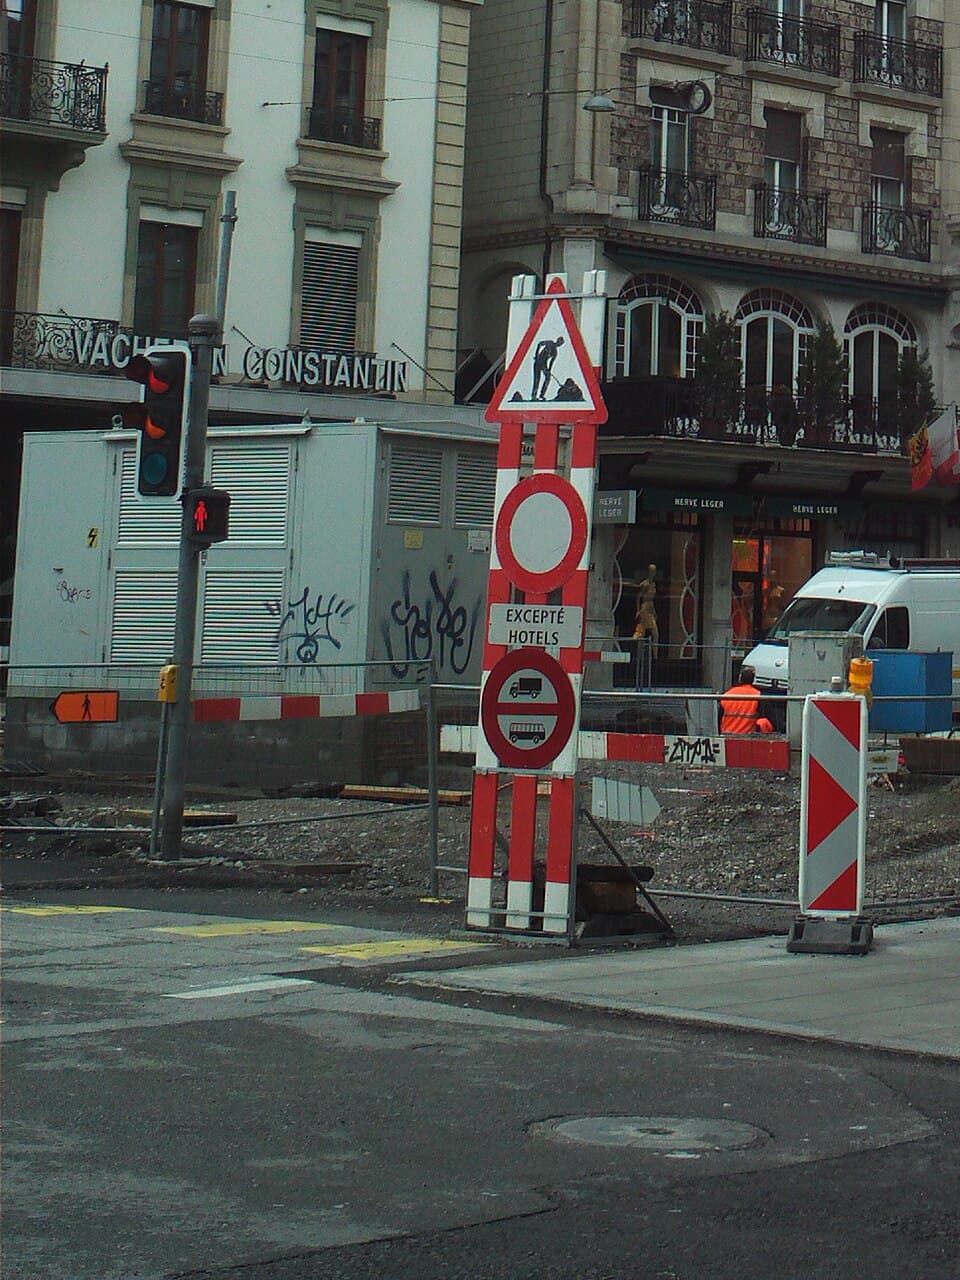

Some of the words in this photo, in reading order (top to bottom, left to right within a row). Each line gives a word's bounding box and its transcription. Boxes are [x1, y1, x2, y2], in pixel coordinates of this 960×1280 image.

[72, 334, 230, 377] VACHN
[243, 345, 411, 393] CONSTANTIN
[506, 607, 566, 625] EXCEPTÉ
[508, 629, 560, 646] HOTELS
